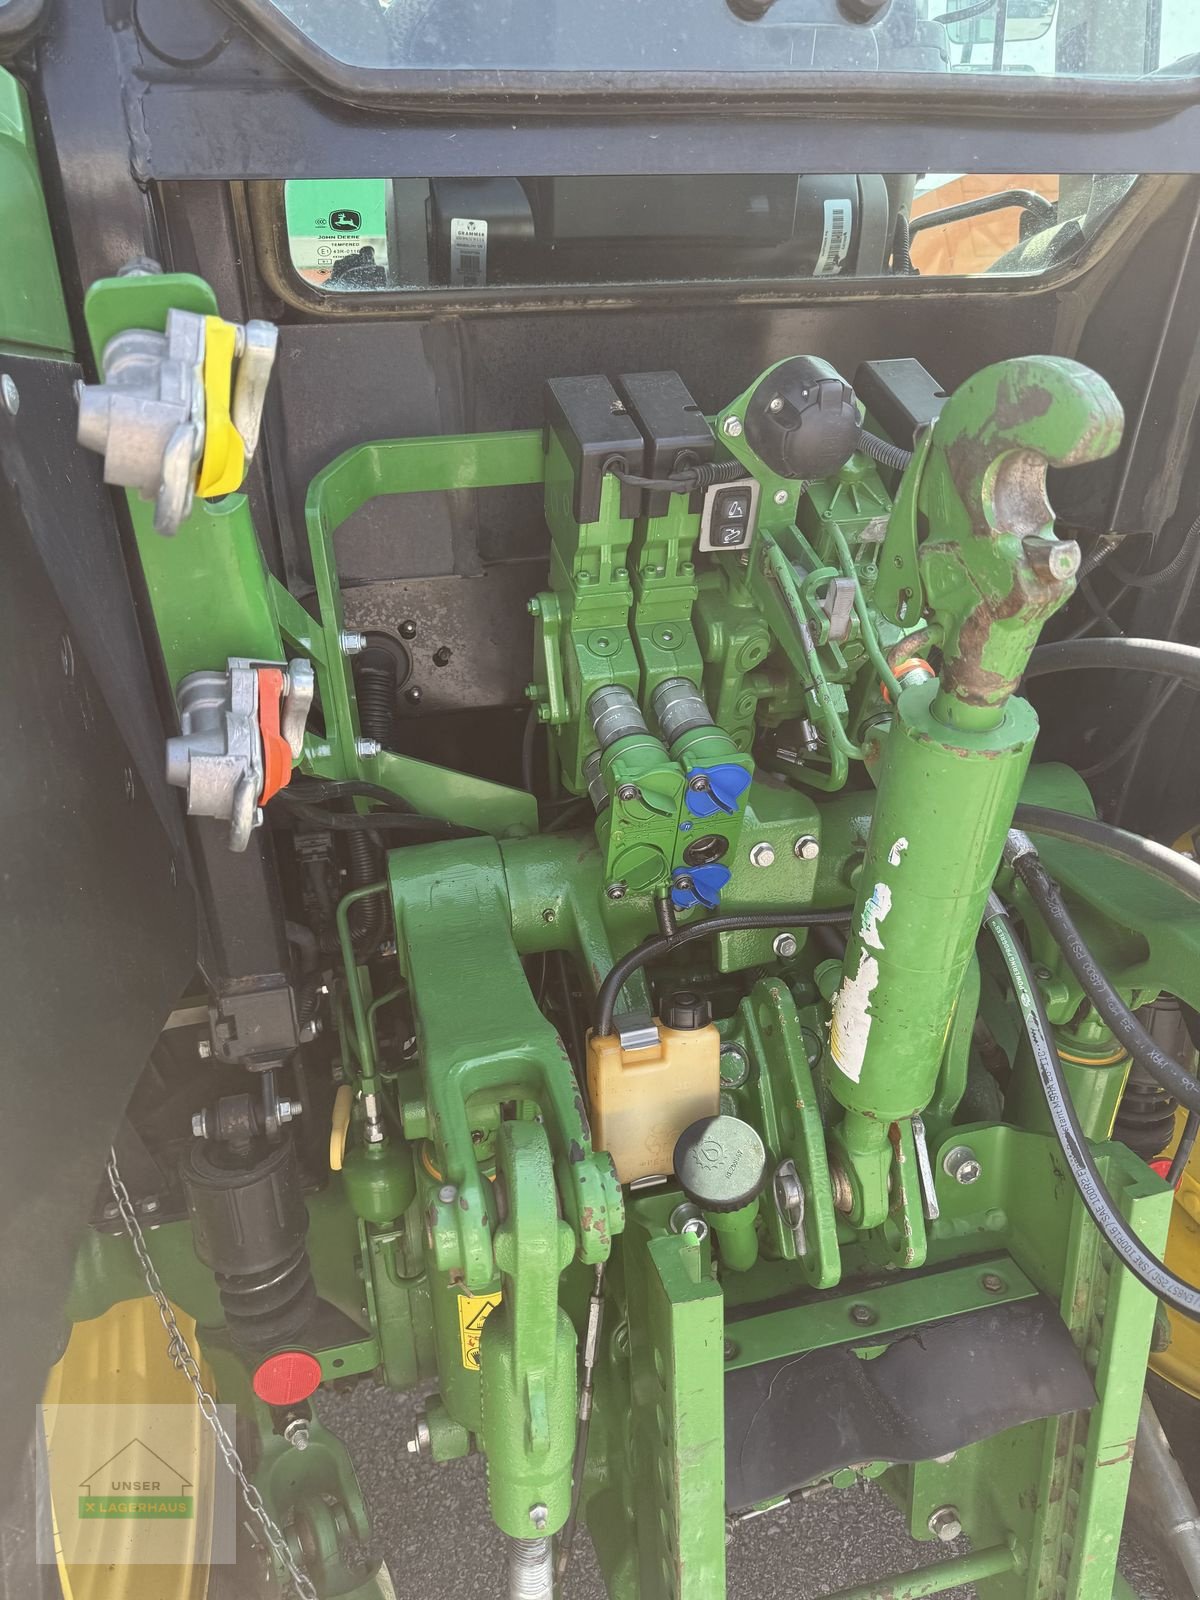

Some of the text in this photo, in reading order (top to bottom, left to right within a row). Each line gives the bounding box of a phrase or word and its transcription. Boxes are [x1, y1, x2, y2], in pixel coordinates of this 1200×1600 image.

[1006, 955, 1026, 990] POWERING
[1147, 1048, 1170, 1069] MAX
[1079, 1178, 1101, 1205] 100R2
[1094, 1205, 1111, 1222] SAE
[1109, 1226, 1136, 1256] 100R16
[1132, 1254, 1150, 1271] SAE
